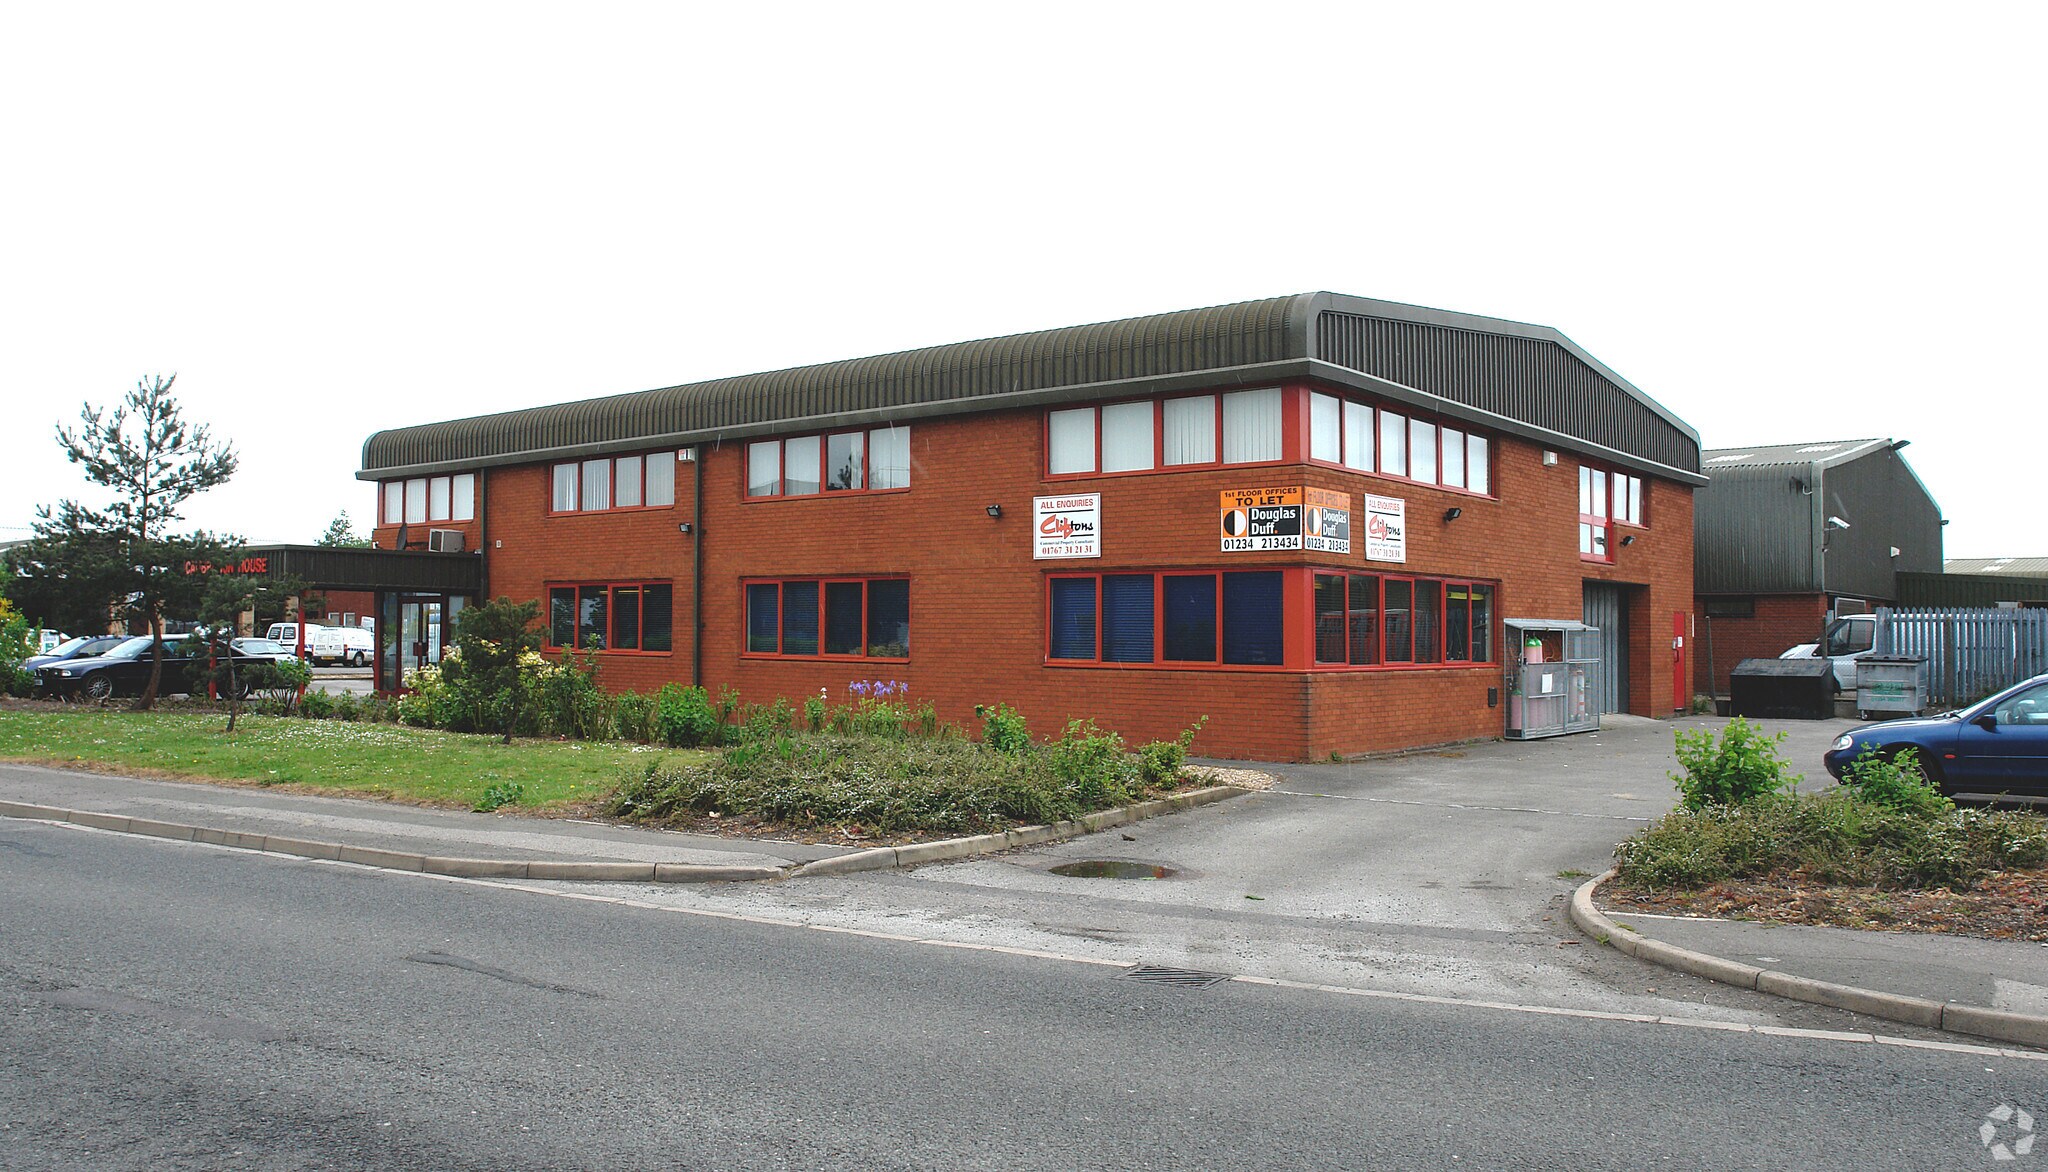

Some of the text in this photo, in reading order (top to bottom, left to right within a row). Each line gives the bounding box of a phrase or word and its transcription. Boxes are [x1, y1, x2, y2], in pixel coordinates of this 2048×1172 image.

[1057, 499, 1094, 508] ENQUIRIES
[1236, 496, 1284, 506] TO LET
[1251, 507, 1296, 522] Douglas
[1323, 509, 1346, 525] Douglas
[1224, 537, 1298, 549] 01234 213434
[1307, 538, 1348, 551] 01234 213434
